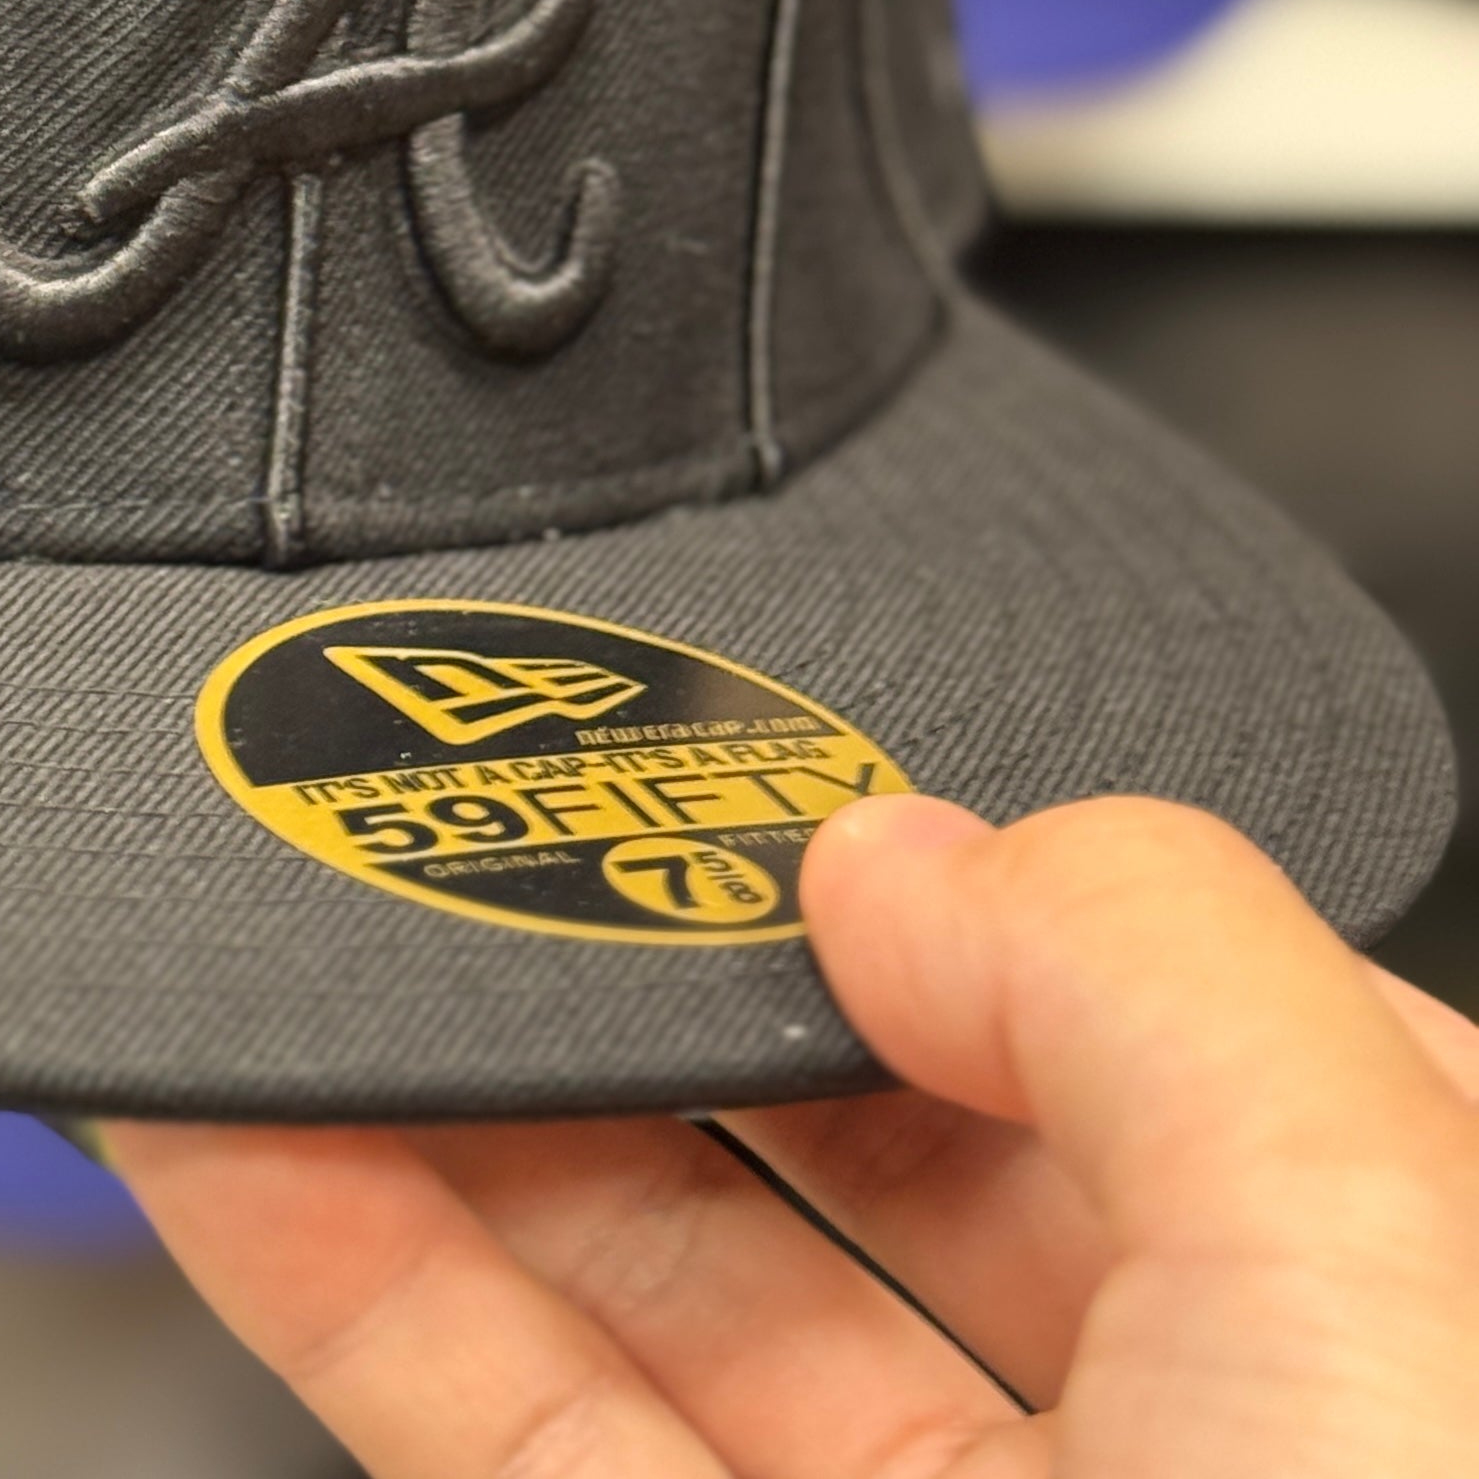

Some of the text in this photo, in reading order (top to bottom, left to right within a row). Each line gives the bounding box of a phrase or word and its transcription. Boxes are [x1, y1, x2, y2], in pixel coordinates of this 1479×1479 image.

[292, 777, 379, 806] IT'S
[379, 767, 468, 794] NOT
[474, 764, 511, 786] A
[687, 745, 726, 767] A
[723, 738, 831, 765] FLAG
[424, 851, 580, 878] ORIGINAL
